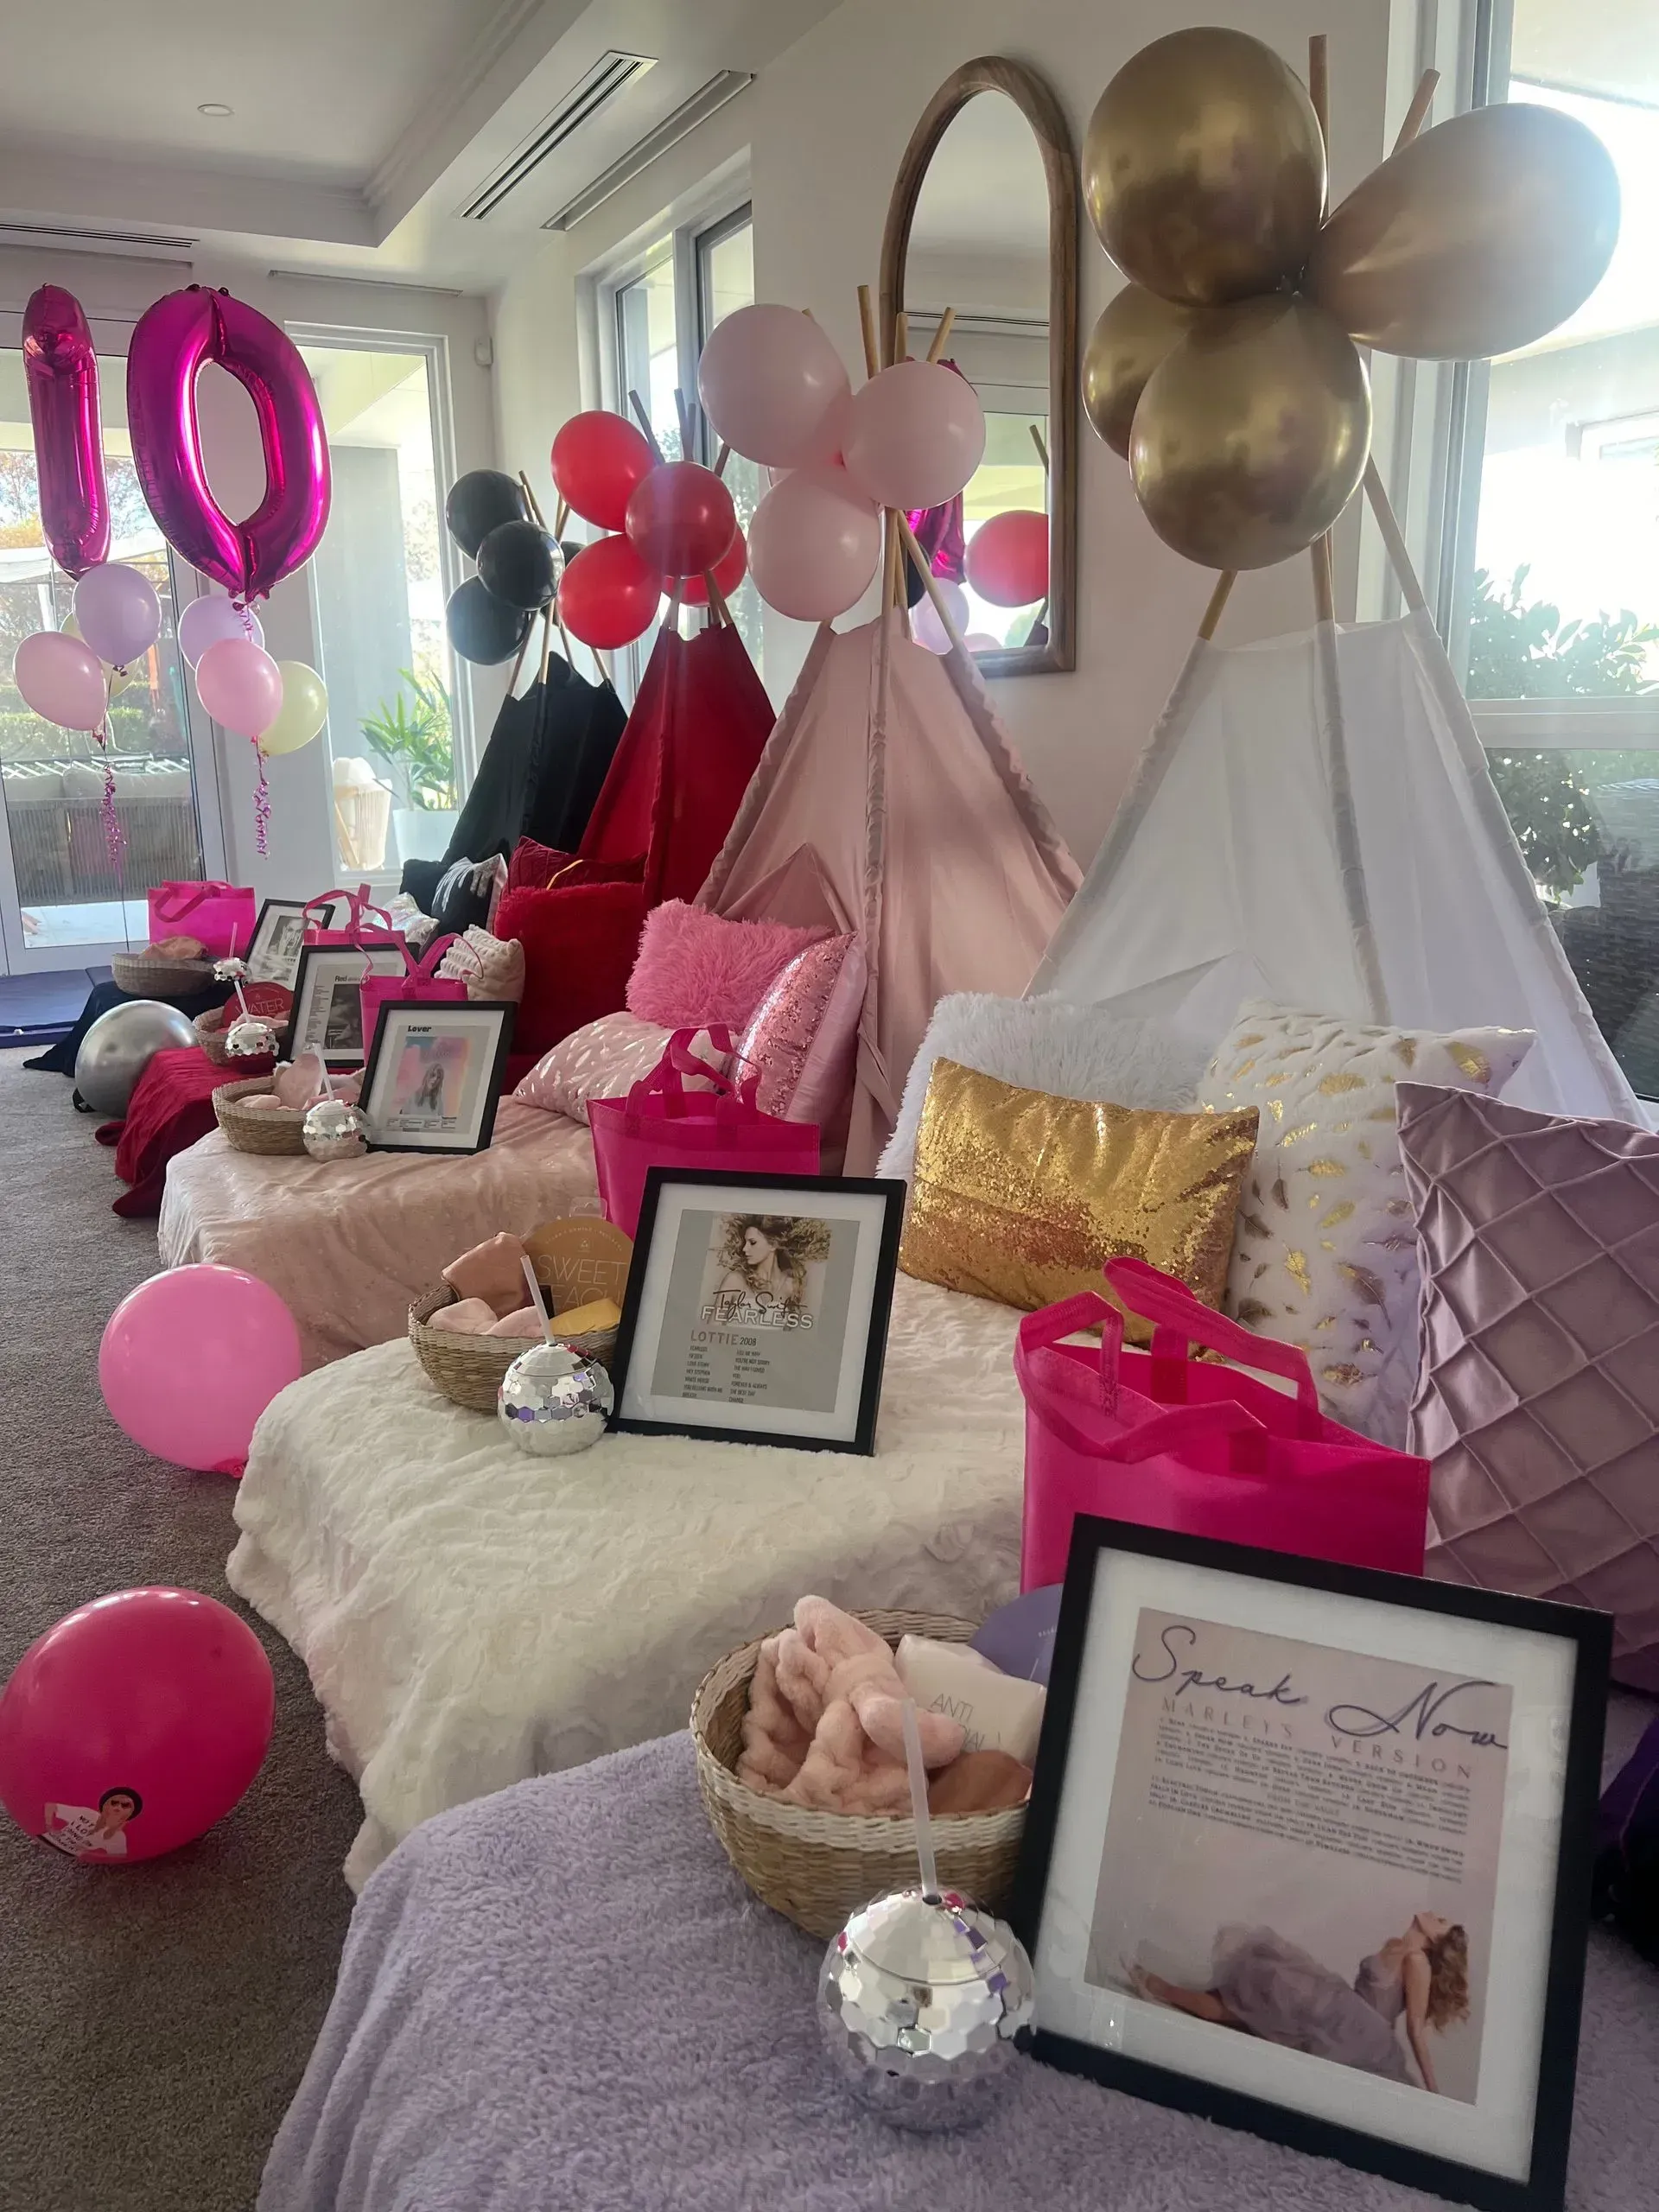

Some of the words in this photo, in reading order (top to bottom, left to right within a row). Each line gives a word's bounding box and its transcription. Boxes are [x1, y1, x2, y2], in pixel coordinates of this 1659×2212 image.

[537, 1255, 627, 1285] SWEET
[701, 1305, 813, 1329] FEARLESS
[690, 1330, 739, 1345] LOTTIE
[740, 1337, 757, 1346] 2008
[1132, 1625, 1303, 1704] Speak
[1325, 1680, 1509, 1750] Now
[931, 1694, 974, 1723] ANTI
[1332, 1735, 1472, 1779] VERSION
